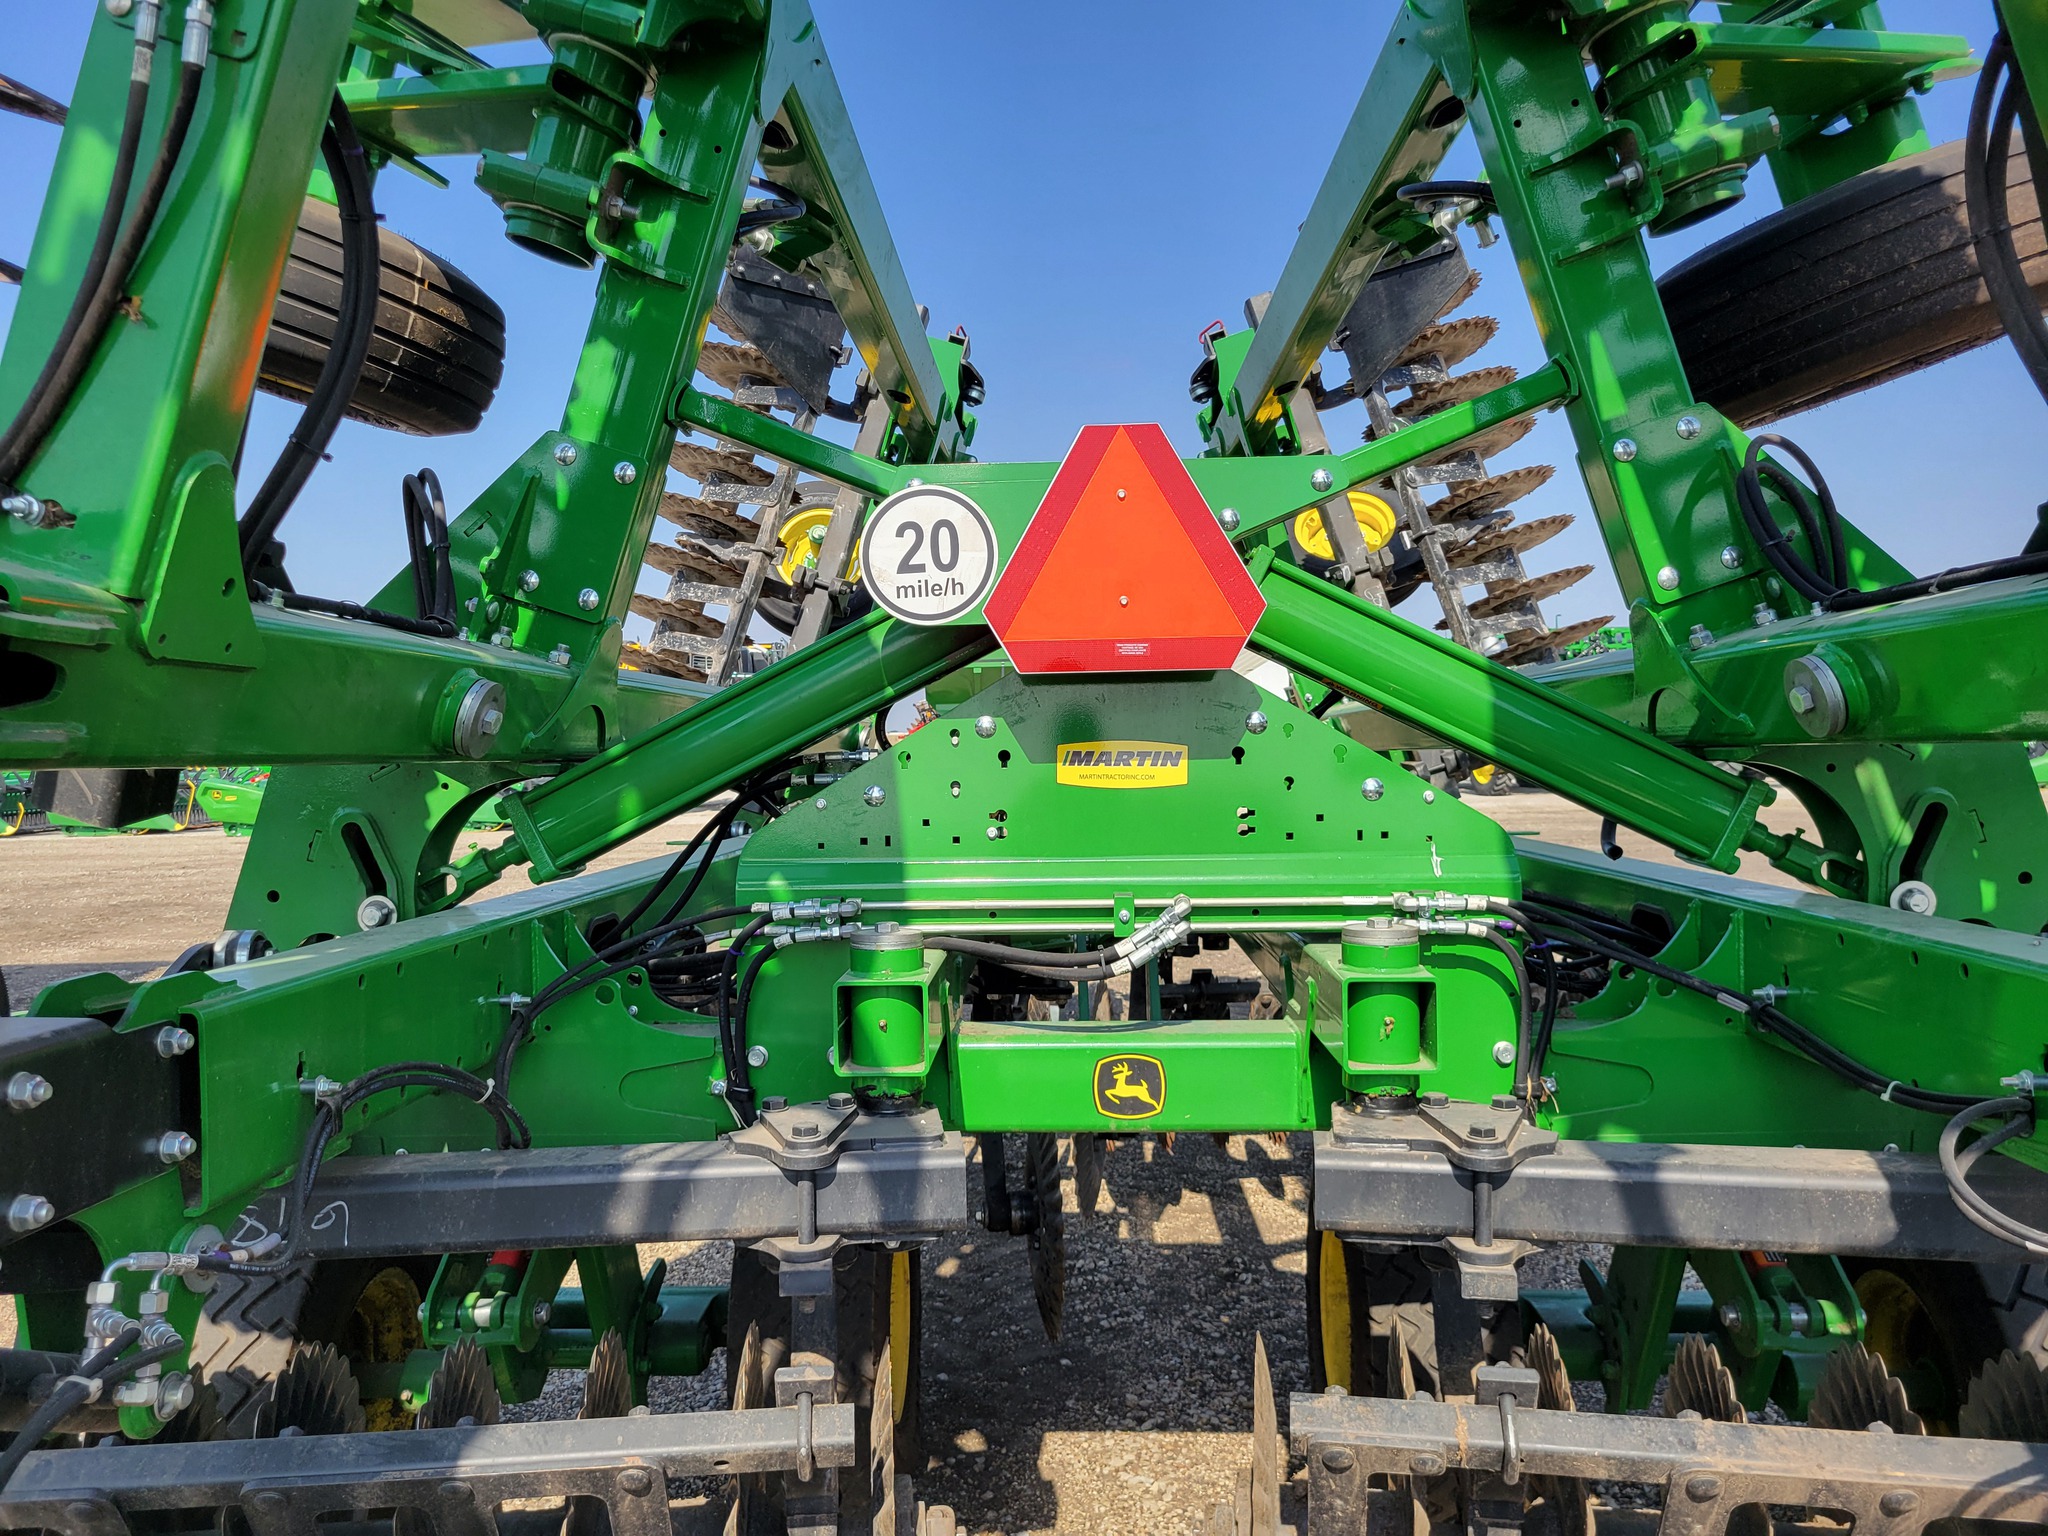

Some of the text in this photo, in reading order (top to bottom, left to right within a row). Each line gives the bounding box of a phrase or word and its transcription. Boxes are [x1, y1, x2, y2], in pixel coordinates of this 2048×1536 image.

[895, 519, 960, 575] 20
[896, 577, 964, 599] mile/h
[1336, 683, 1378, 708] WARNING
[1066, 750, 1183, 767] MARTIN
[1078, 773, 1156, 782] MARTINTRACTORINC.COM
